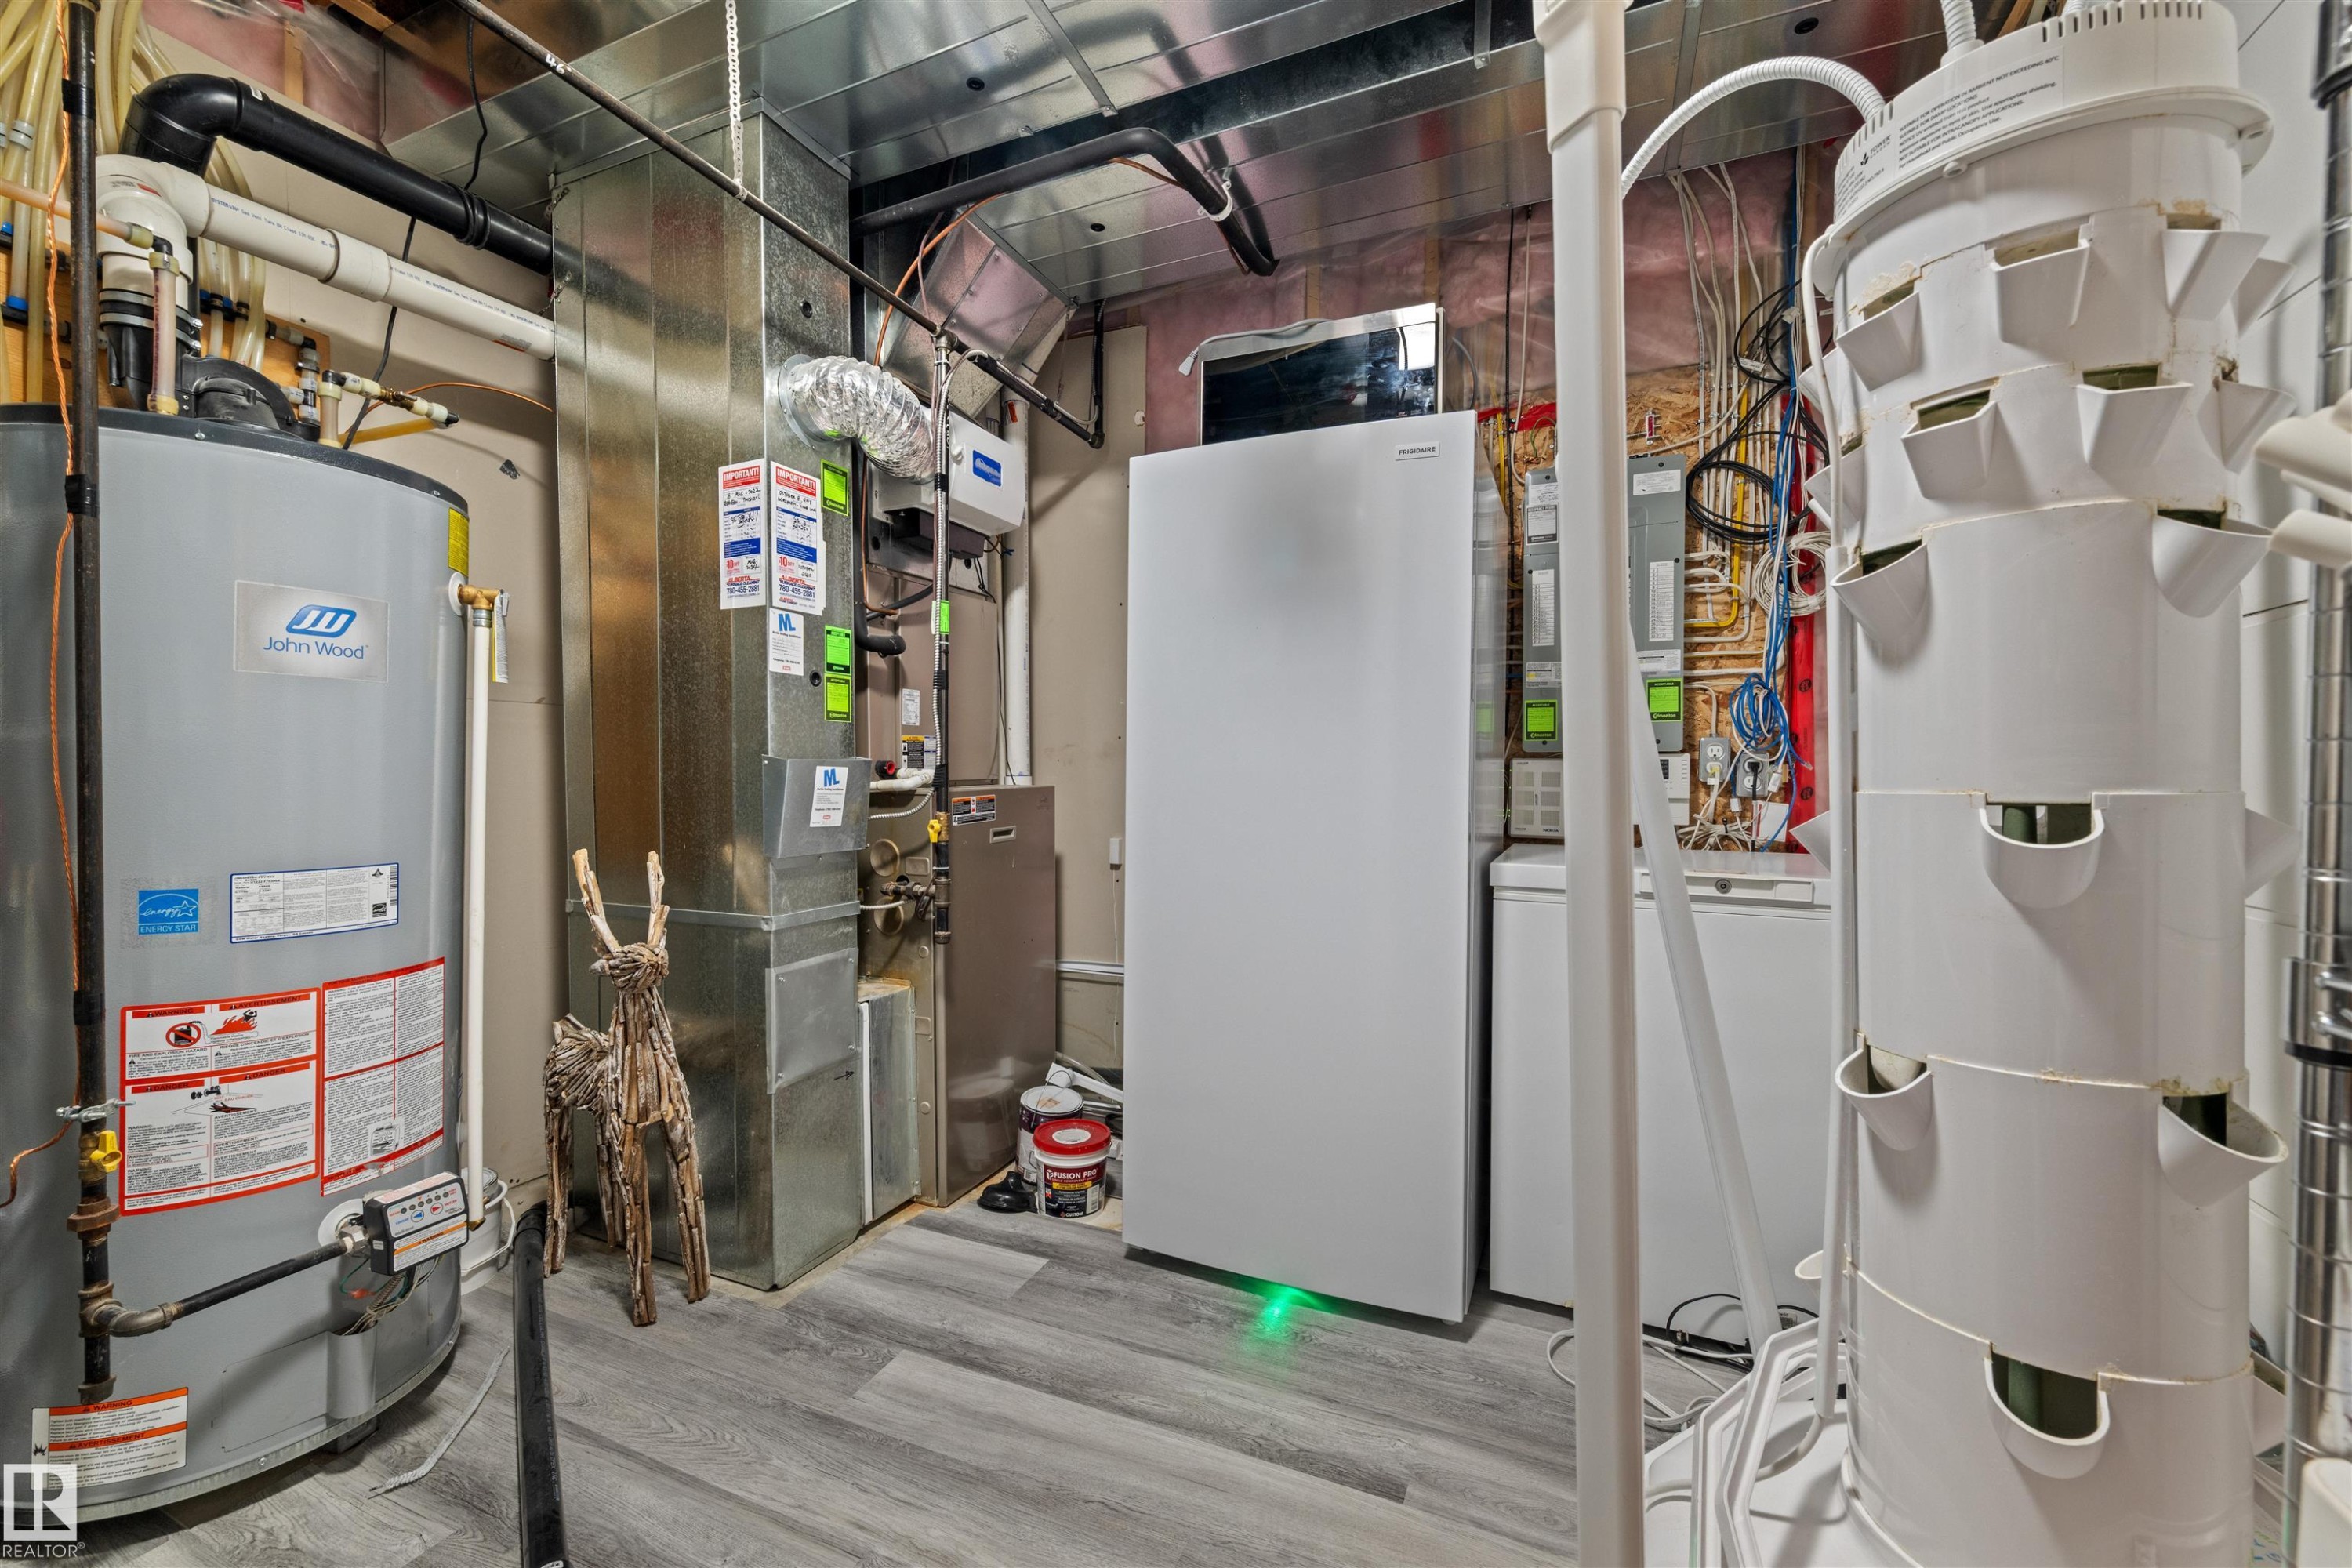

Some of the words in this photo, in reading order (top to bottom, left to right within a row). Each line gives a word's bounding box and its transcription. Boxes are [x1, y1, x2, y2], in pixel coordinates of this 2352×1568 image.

[1995, 73, 2009, 82] NOT
[1870, 135, 1891, 154] TOWER
[1399, 446, 1436, 456] FRIGIDAIRE
[724, 467, 760, 481] IMPORTANT!
[777, 468, 815, 489] IMPORTANT!
[779, 575, 806, 584] ALBERTA
[727, 585, 760, 594] 780-455-2881
[779, 584, 815, 598] 780-455-2881
[263, 636, 310, 654] John
[314, 641, 365, 659] Wood
[140, 925, 174, 934] ENERGY
[238, 995, 302, 1009] AVERTISSEMENT
[154, 1007, 194, 1016] WARNING
[252, 1068, 286, 1078] DANGER
[153, 1082, 190, 1091] DANGER
[1083, 1168, 1097, 1178] PRO
[93, 1399, 133, 1410] WARNING
[78, 1432, 146, 1448] AVERTISSEMENT
